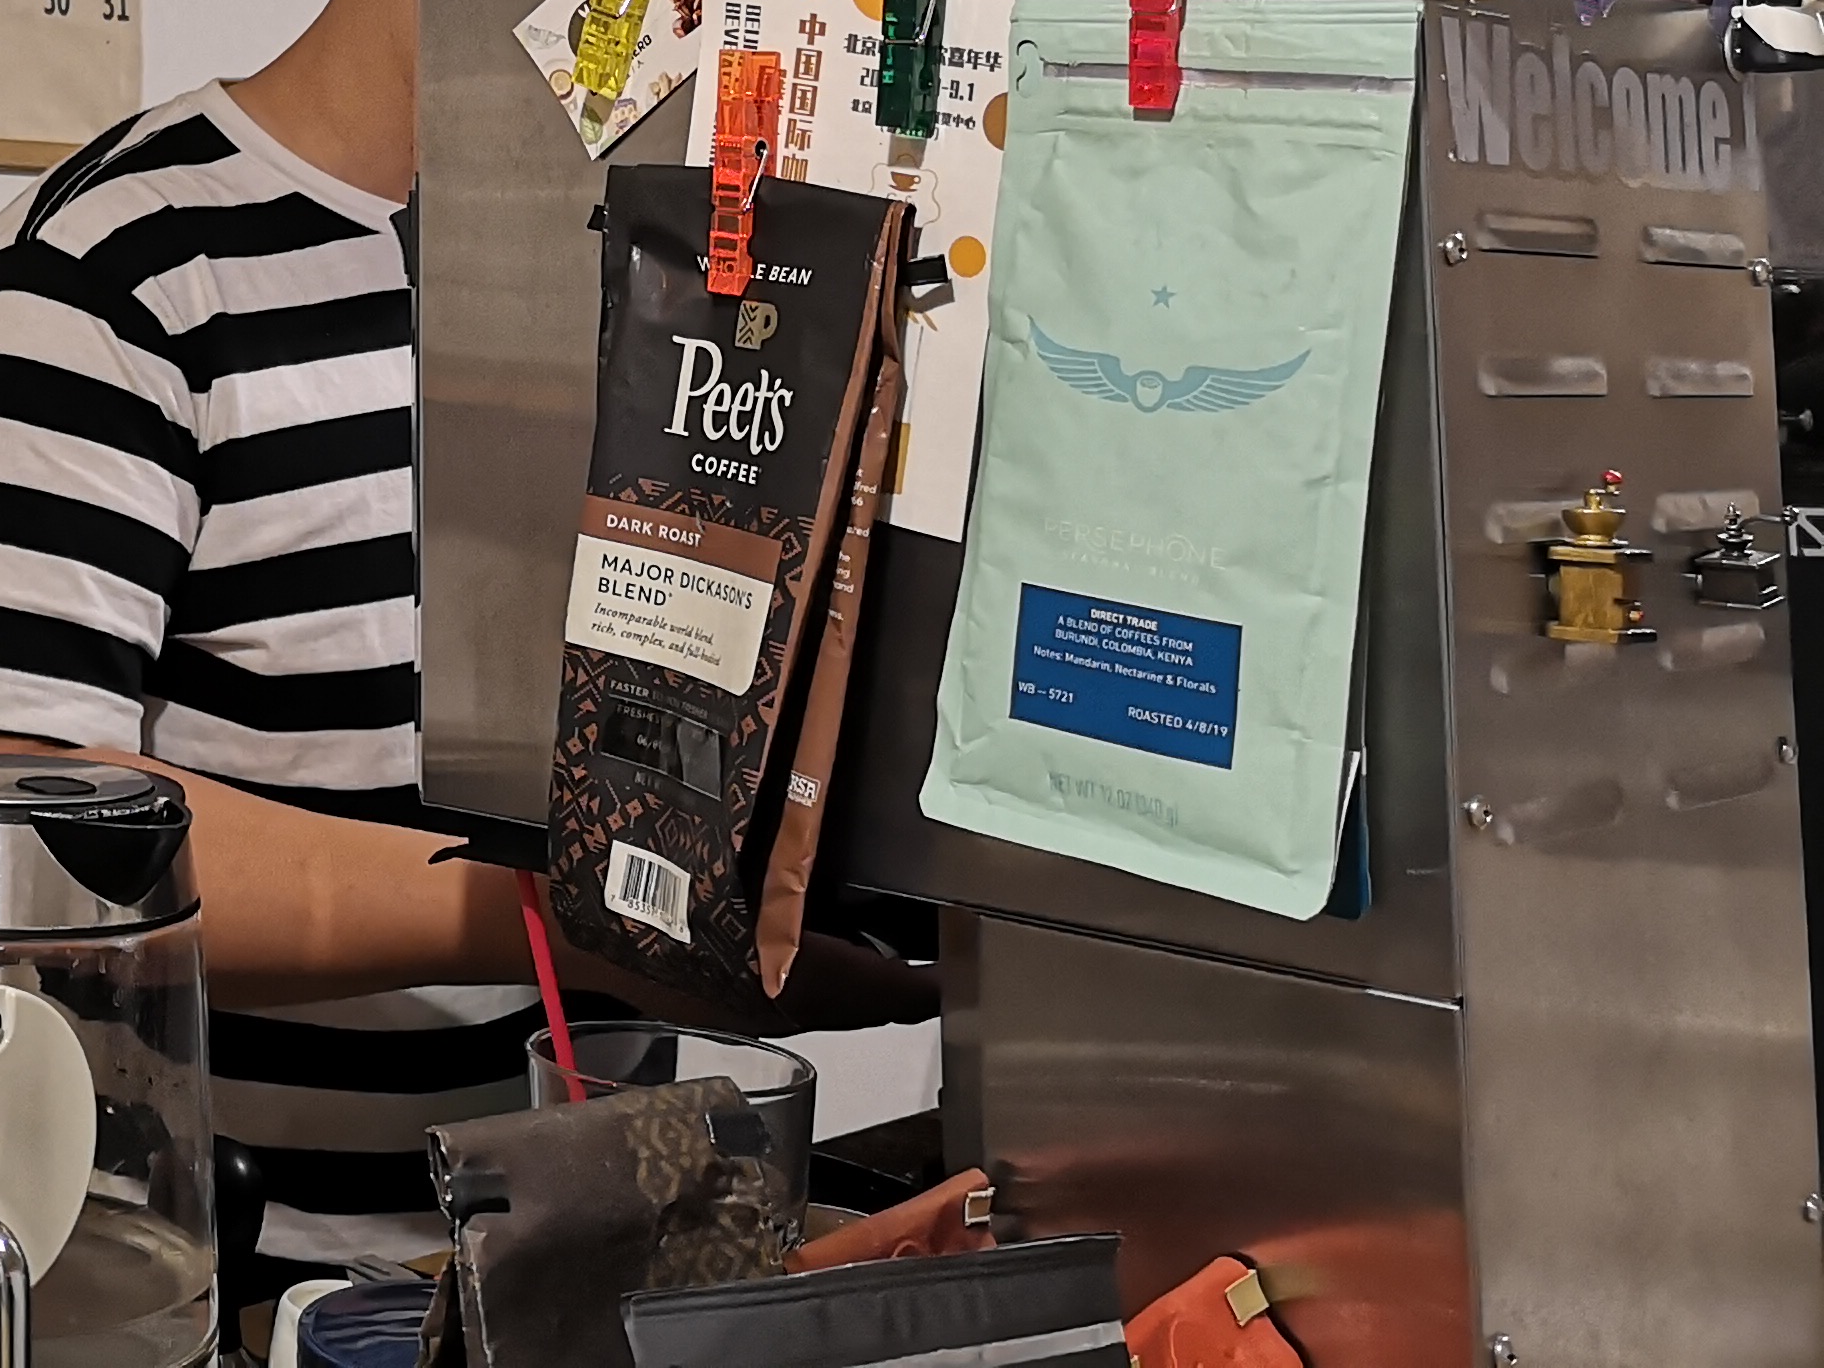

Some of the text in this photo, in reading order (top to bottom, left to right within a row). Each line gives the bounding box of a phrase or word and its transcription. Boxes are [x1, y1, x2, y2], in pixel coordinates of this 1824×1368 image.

[769, 263, 813, 286] BEAN
[663, 334, 794, 455] Peet's
[690, 452, 760, 485] COFFEE
[606, 513, 702, 548] DARK ROAST
[598, 576, 667, 607] BLEND
[601, 553, 753, 610] MAJOR DICKASON'S
[594, 602, 667, 630] Incomparable
[1090, 608, 1158, 631] DIRECT TRADE
[590, 621, 616, 637] rich,
[620, 629, 666, 650] complex,
[1057, 615, 1193, 652] A BLEND OF COFFEES FROM
[1033, 645, 1063, 661] Notes:
[1114, 664, 1163, 683] Nectarine
[1165, 674, 1175, 686] &
[1176, 676, 1216, 694] Florals
[1157, 650, 1194, 666] KENYA
[609, 679, 649, 698] FASTER
[1048, 688, 1074, 704] 5721
[1128, 706, 1229, 738] ROASTED 4/8/19
